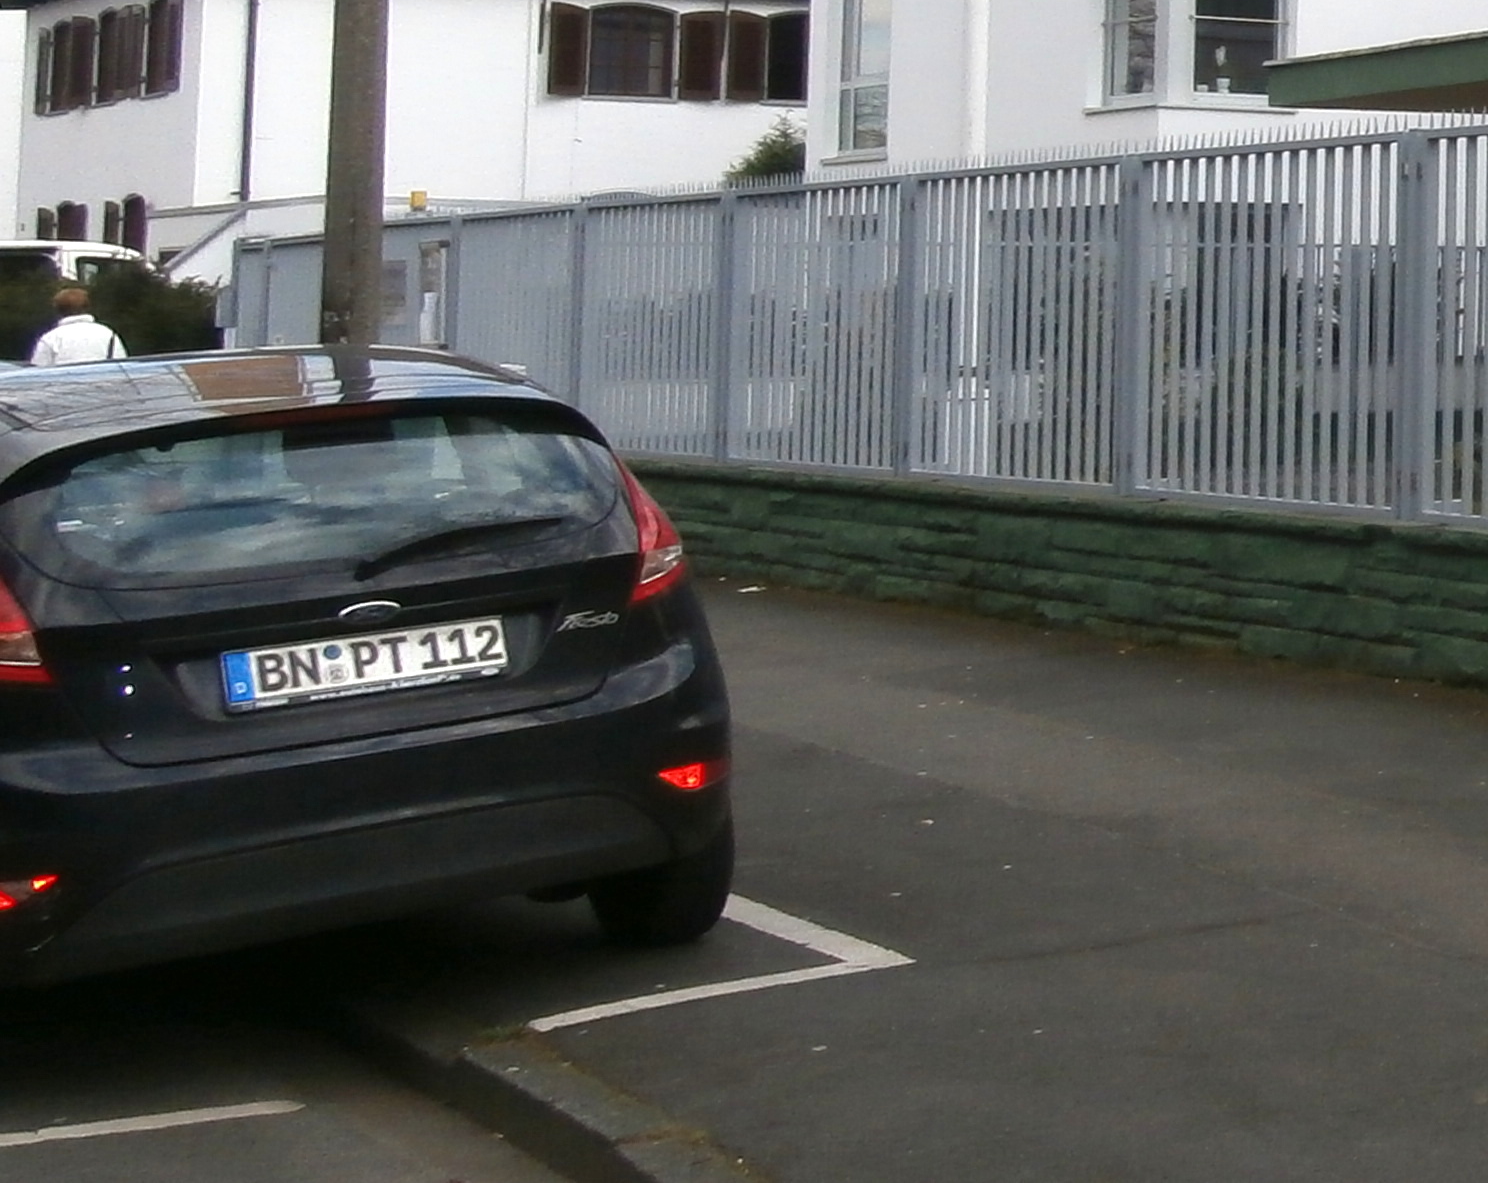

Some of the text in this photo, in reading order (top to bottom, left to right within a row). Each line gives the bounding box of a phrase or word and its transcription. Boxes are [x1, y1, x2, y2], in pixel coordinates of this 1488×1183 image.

[257, 649, 323, 693] BN
[349, 635, 409, 678] PT
[418, 624, 504, 670] 112
